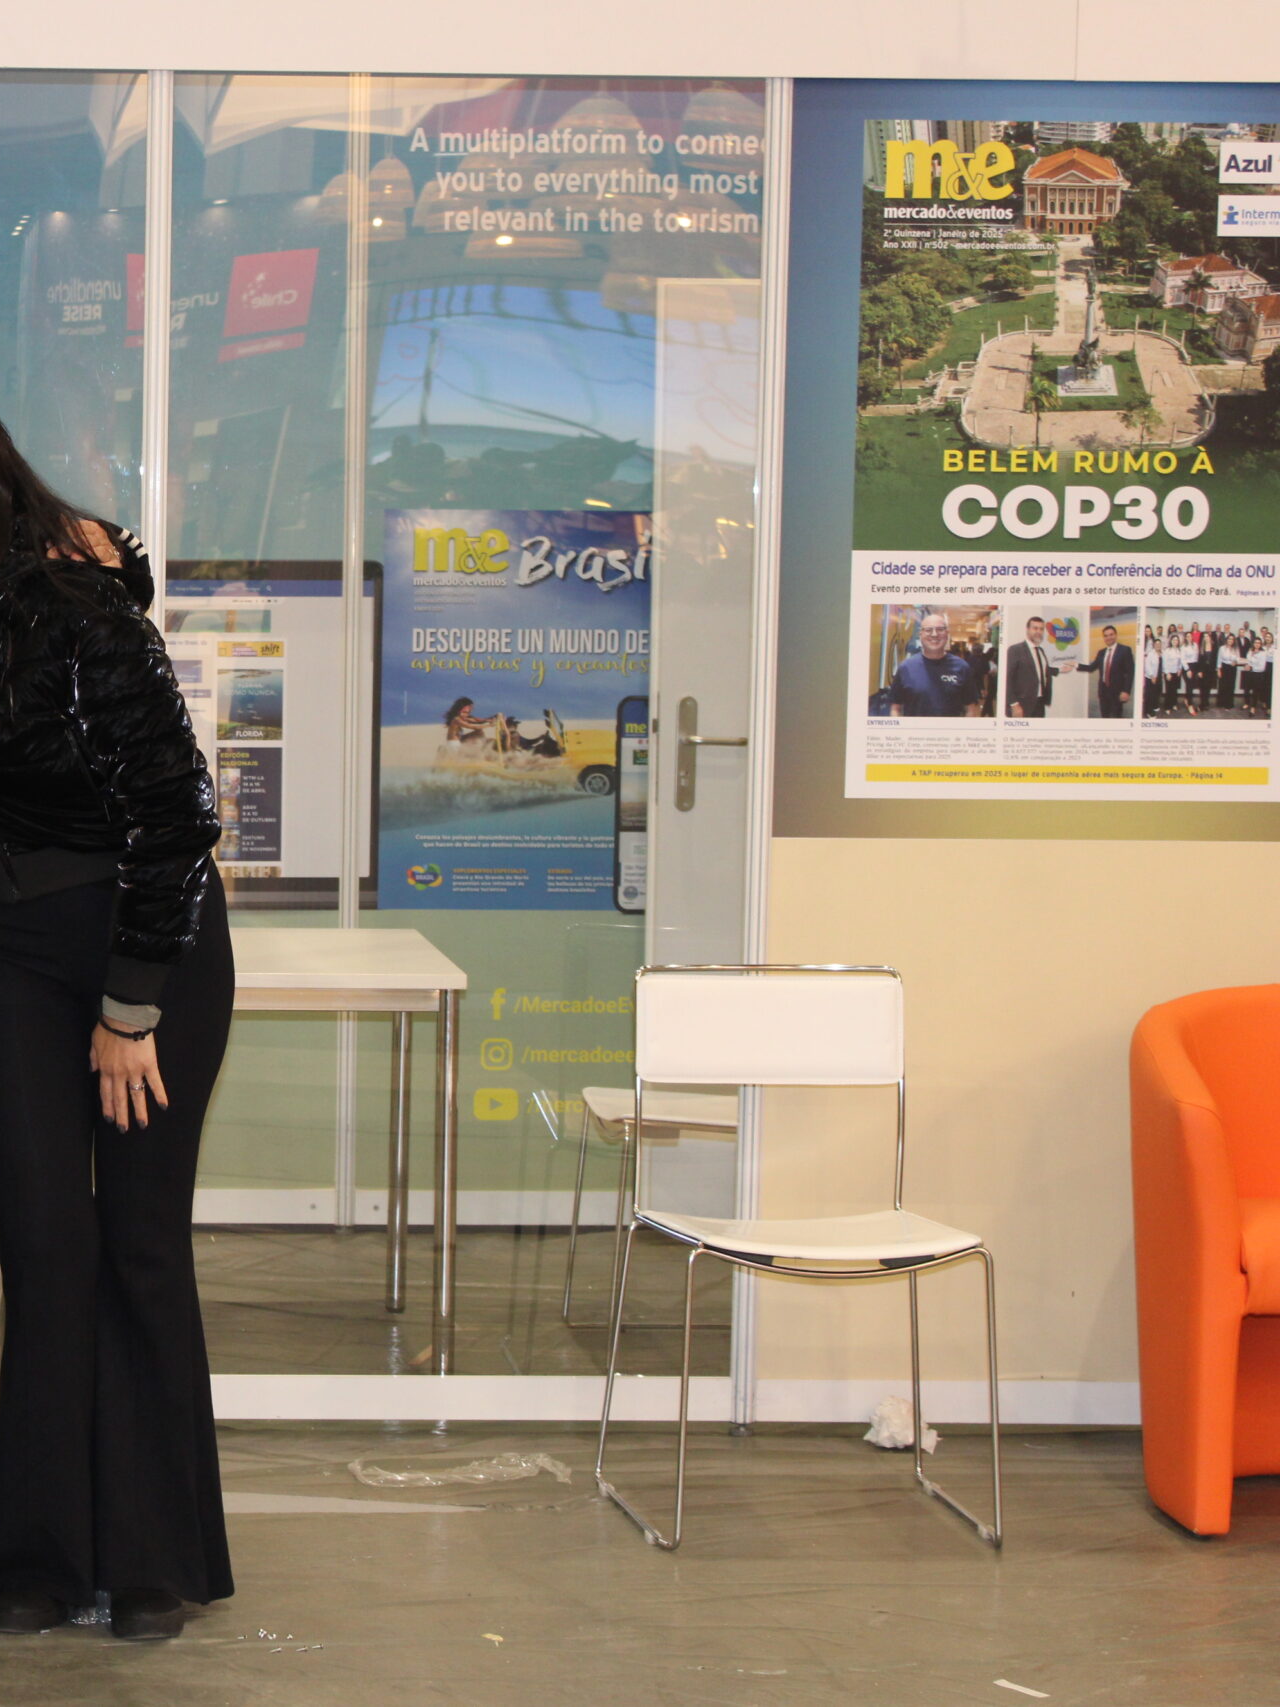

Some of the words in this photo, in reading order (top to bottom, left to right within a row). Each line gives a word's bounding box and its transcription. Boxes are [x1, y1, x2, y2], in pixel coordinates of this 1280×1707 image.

[409, 127, 429, 153] A
[440, 128, 626, 159] multiplatform
[636, 129, 664, 154] to
[884, 139, 1016, 201] m&e
[1224, 153, 1272, 173] Azul
[437, 171, 493, 199] you
[496, 167, 523, 192] to
[534, 168, 679, 200] everything
[690, 170, 759, 195] most
[444, 207, 555, 232] relevant
[565, 206, 588, 232] in
[599, 207, 643, 233] the
[654, 208, 758, 233] tourism
[883, 203, 1014, 220] mercado&eventos
[883, 241, 899, 249] Ano
[901, 241, 917, 249] XXII
[894, 229, 931, 238] Quinzena
[938, 229, 966, 238] Janeiro
[969, 230, 980, 238] de
[982, 231, 1004, 239] 2025
[943, 447, 1058, 473] BELÉM
[1074, 450, 1178, 475] RUMO
[1190, 446, 1215, 475] À
[941, 483, 1210, 541] COP30
[413, 527, 510, 574] m&e
[412, 576, 507, 587] mercado&eventos
[871, 562, 916, 576] Cidade
[919, 565, 934, 576] se
[938, 564, 987, 578] prepara
[990, 564, 1018, 578] para
[1022, 563, 1072, 576] receber
[1075, 567, 1083, 576] a
[1086, 563, 1162, 577] Conferência
[1166, 564, 1182, 577] do
[1186, 564, 1221, 577] Clima
[1226, 564, 1242, 577] da
[1246, 564, 1275, 578] ONU
[871, 585, 901, 594] Evento
[903, 585, 941, 594] promete
[978, 586, 1006, 595] divisor
[1010, 586, 1021, 595] de
[1024, 586, 1050, 595] águas
[1052, 586, 1072, 595] para
[1084, 586, 1106, 595] setor
[1109, 586, 1145, 595] turístico
[1148, 586, 1160, 595] do
[1163, 586, 1192, 595] Estado
[1195, 586, 1206, 595] do
[1210, 587, 1231, 596] Pará.
[412, 628, 512, 653] DESCUBRE
[518, 629, 544, 654] UN
[550, 629, 619, 654] MUNDO
[626, 629, 649, 654] DE
[411, 652, 523, 675] aventuras
[531, 660, 546, 688] y
[556, 653, 650, 674] encantos
